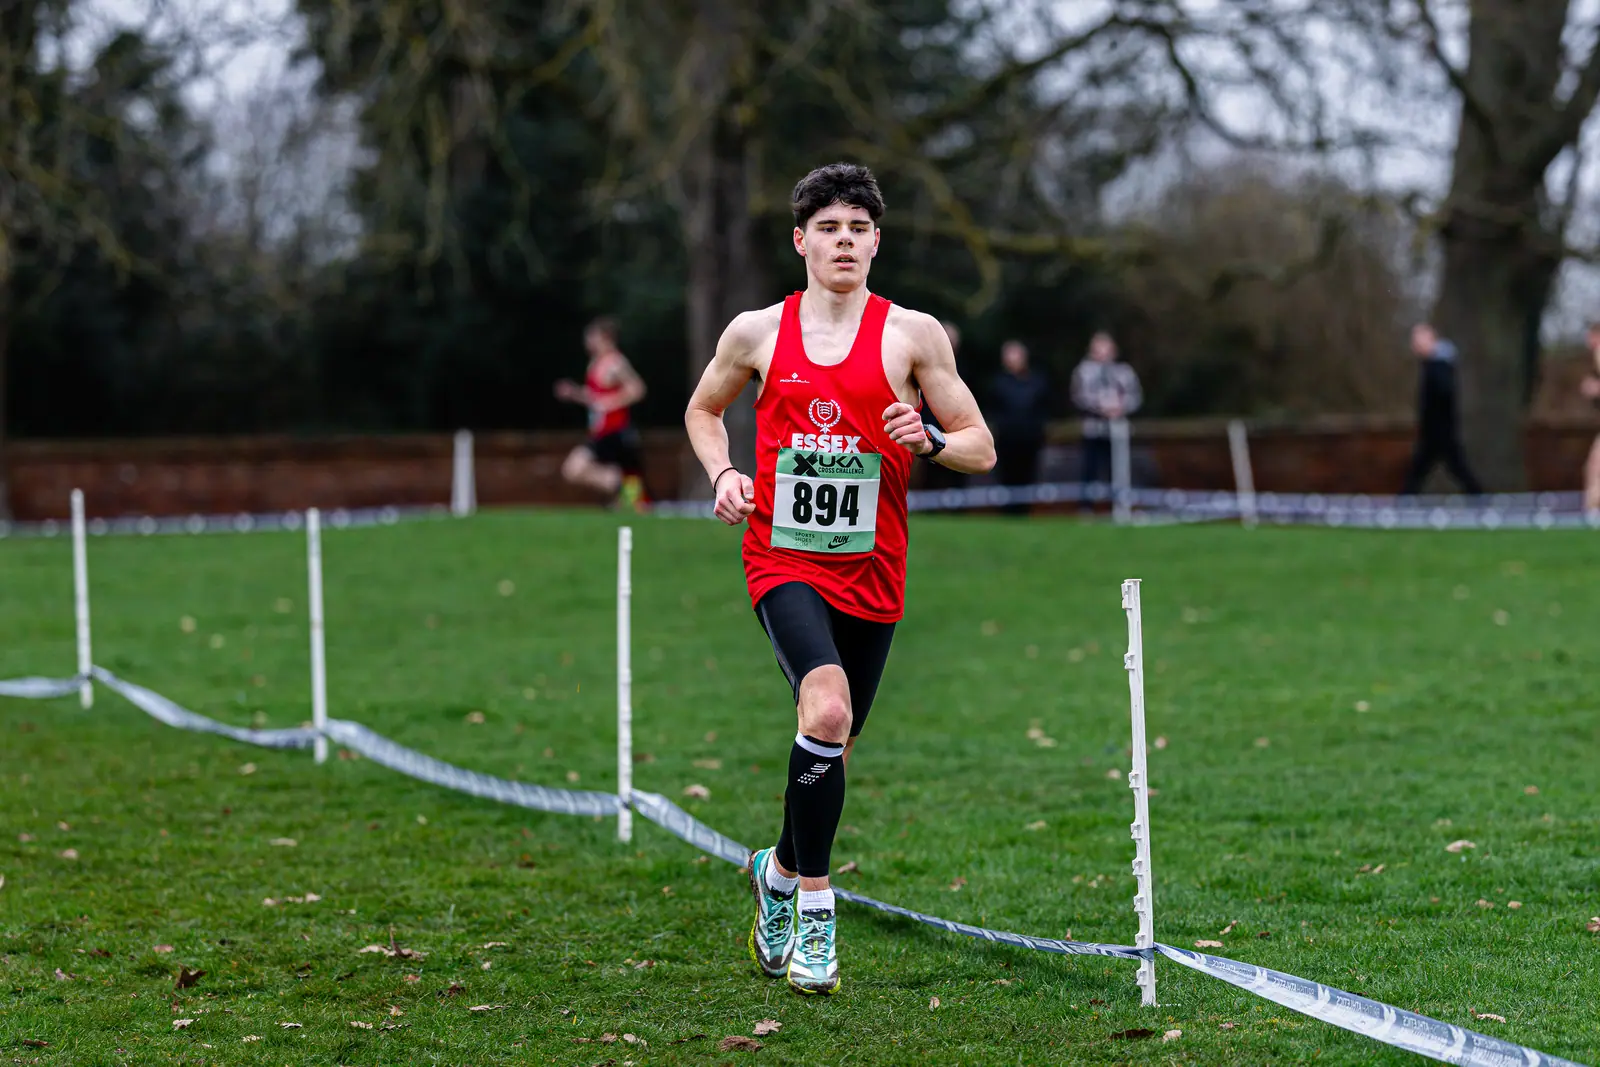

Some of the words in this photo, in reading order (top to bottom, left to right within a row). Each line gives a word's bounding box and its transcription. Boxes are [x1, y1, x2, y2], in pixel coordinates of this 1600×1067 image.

[791, 433, 861, 453] ESSEX
[819, 455, 864, 468] UKA
[836, 467, 864, 475] CHALLENGE
[792, 482, 859, 526] 894
[832, 535, 850, 543] RUN
